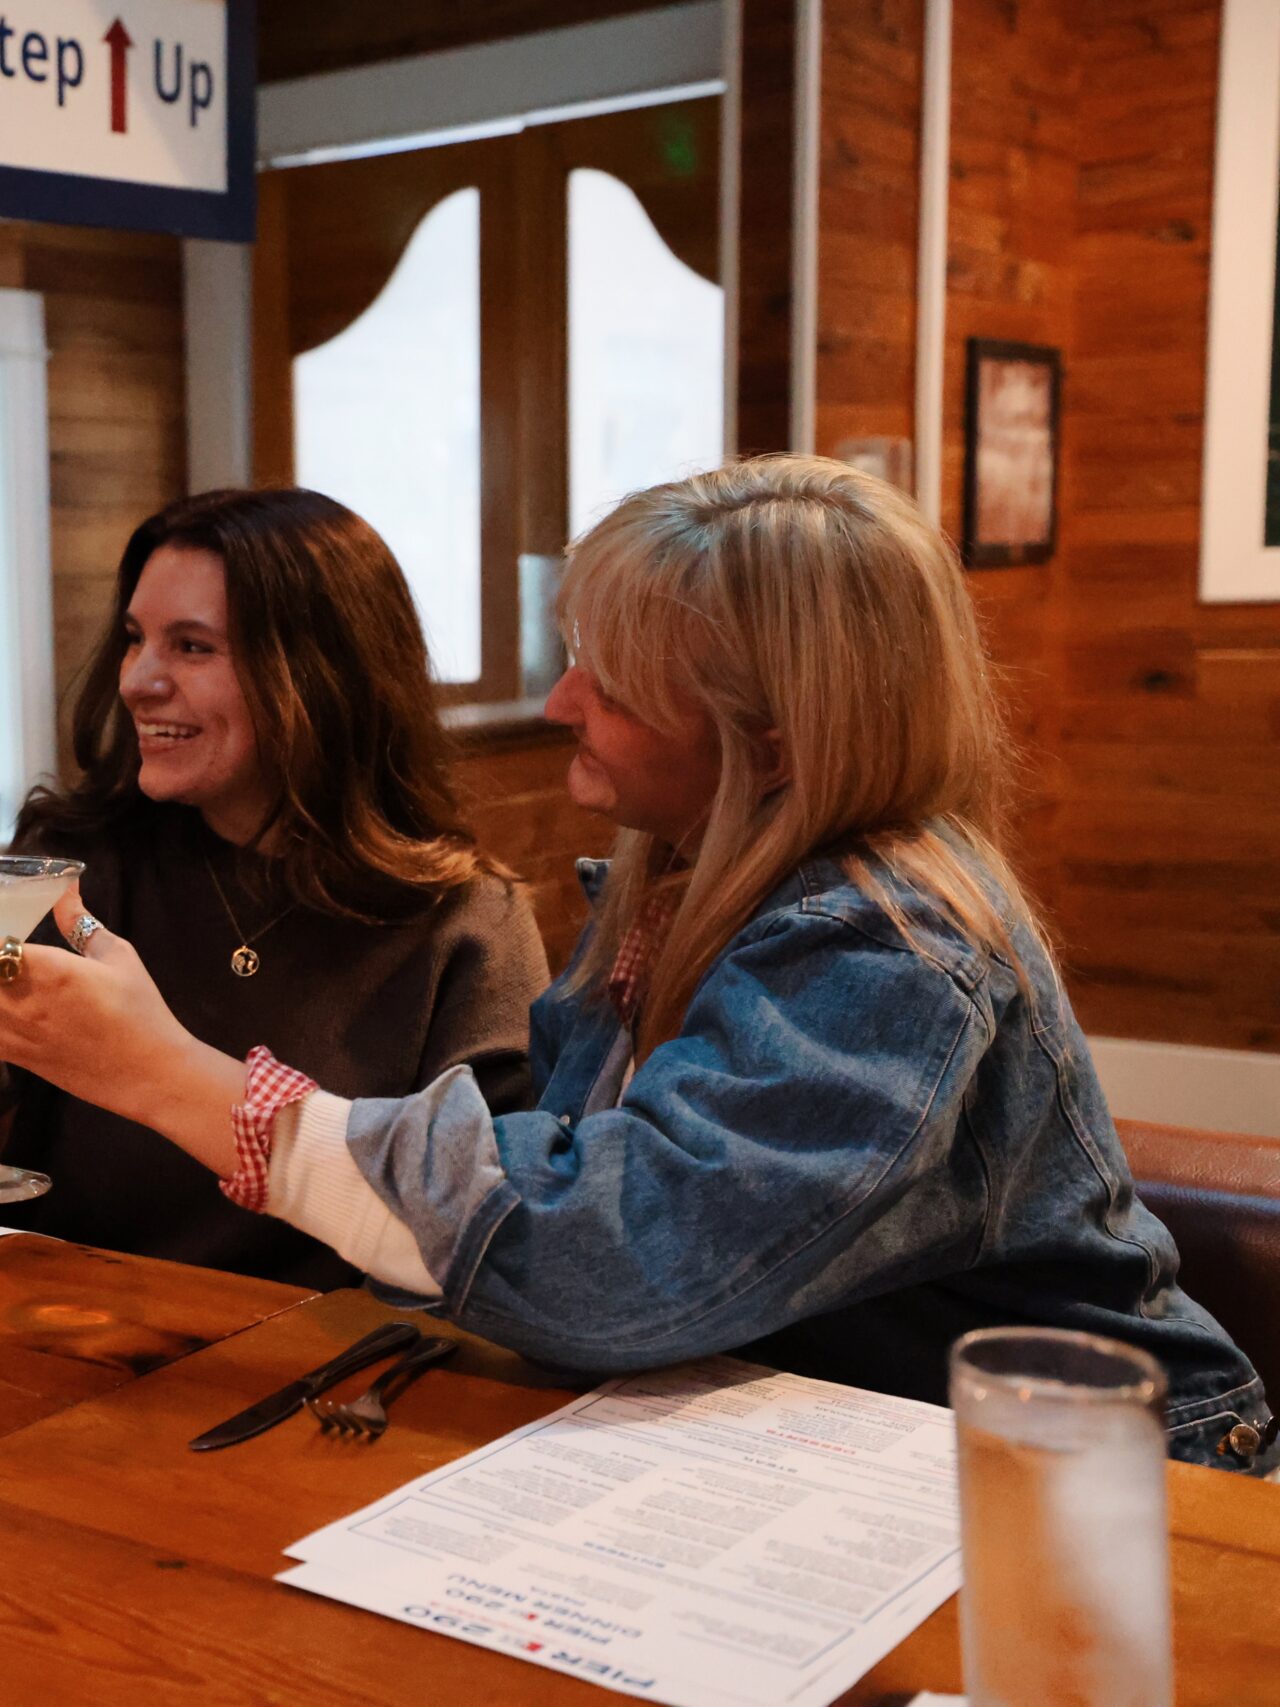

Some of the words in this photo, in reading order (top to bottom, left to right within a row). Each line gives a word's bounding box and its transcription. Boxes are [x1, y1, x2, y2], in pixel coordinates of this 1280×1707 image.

[154, 38, 214, 129] Up
[446, 1588, 506, 1611] 290
[447, 1574, 527, 1604] MENU
[403, 1606, 493, 1637] 290
[533, 1601, 642, 1638] DINNER
[543, 1620, 611, 1646] PIER
[551, 1652, 656, 1689] PIER
